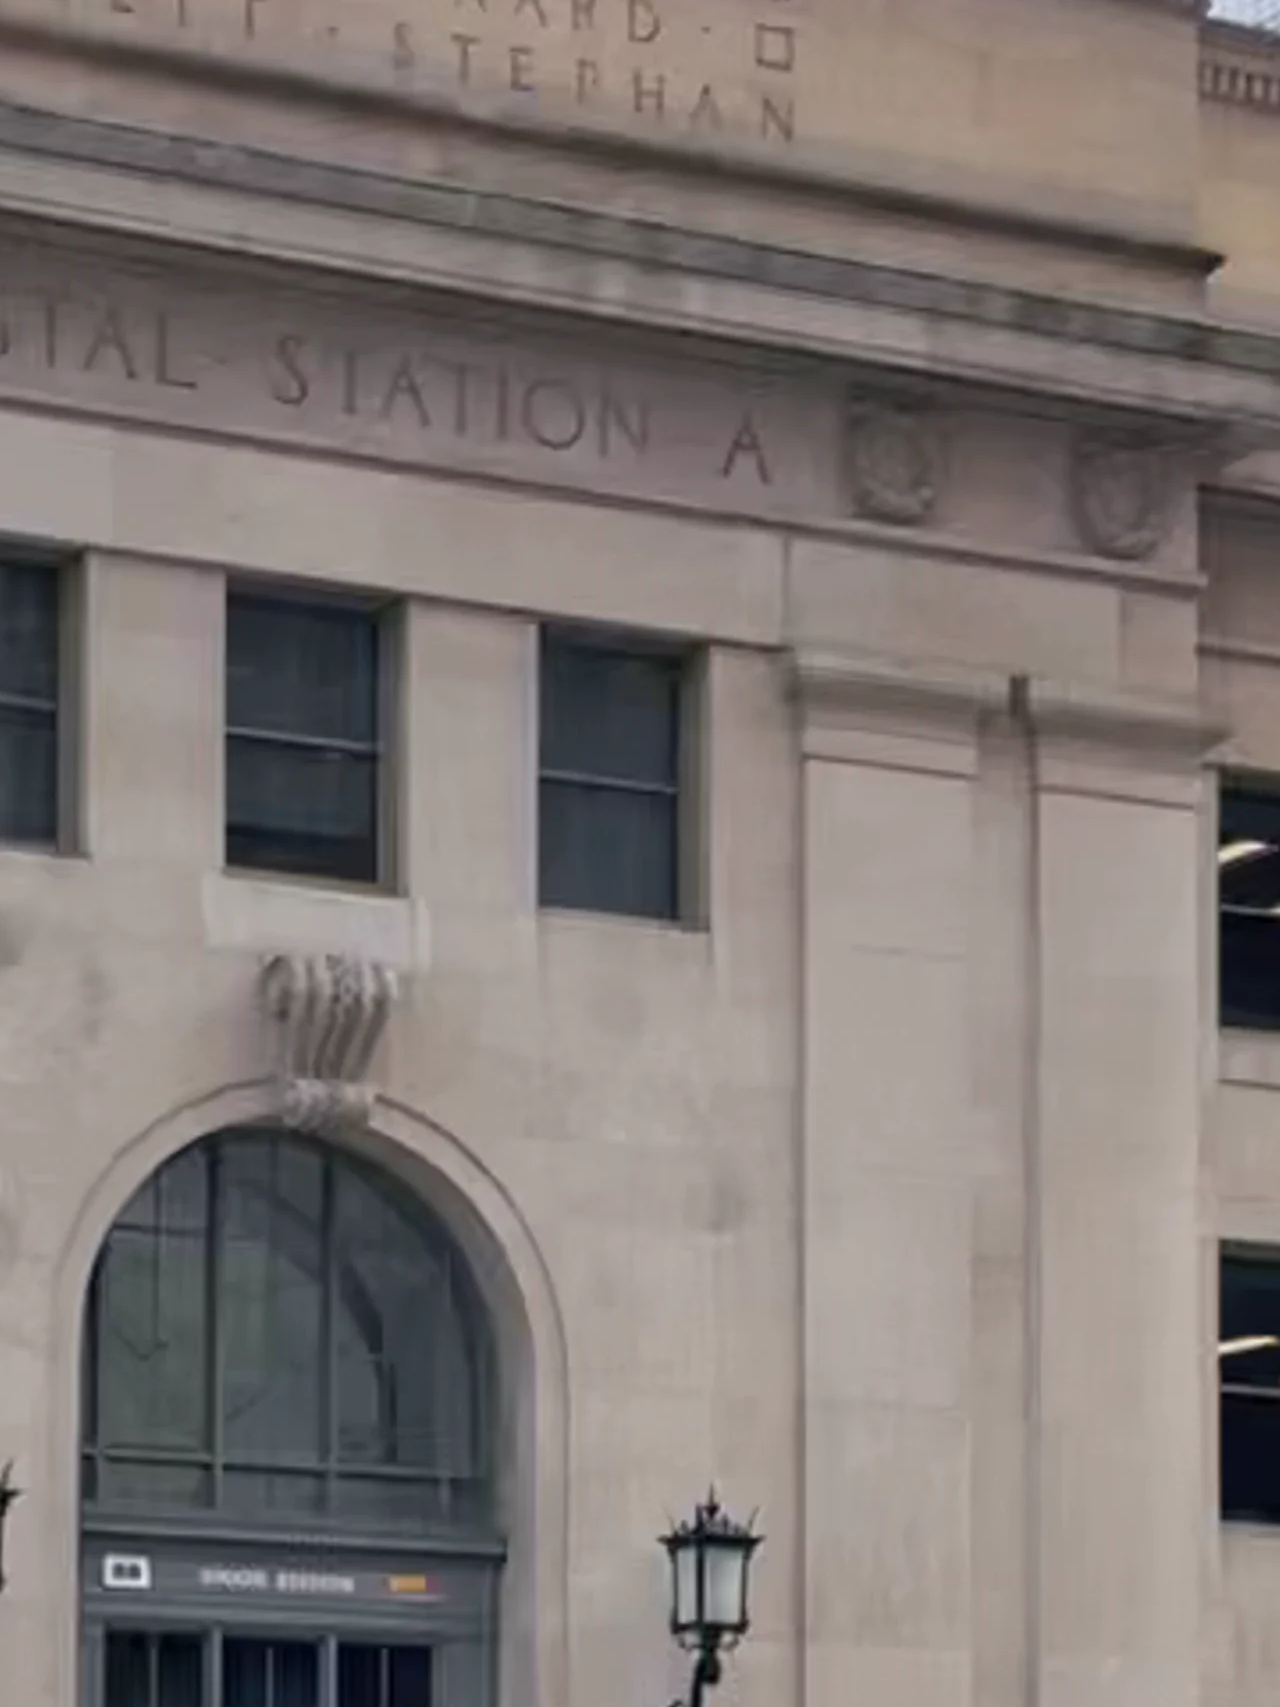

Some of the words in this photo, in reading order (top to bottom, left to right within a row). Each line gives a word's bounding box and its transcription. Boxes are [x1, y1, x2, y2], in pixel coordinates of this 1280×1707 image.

[391, 20, 796, 144] STEPHAN
[272, 332, 652, 460] STATION
[721, 409, 773, 485] A
